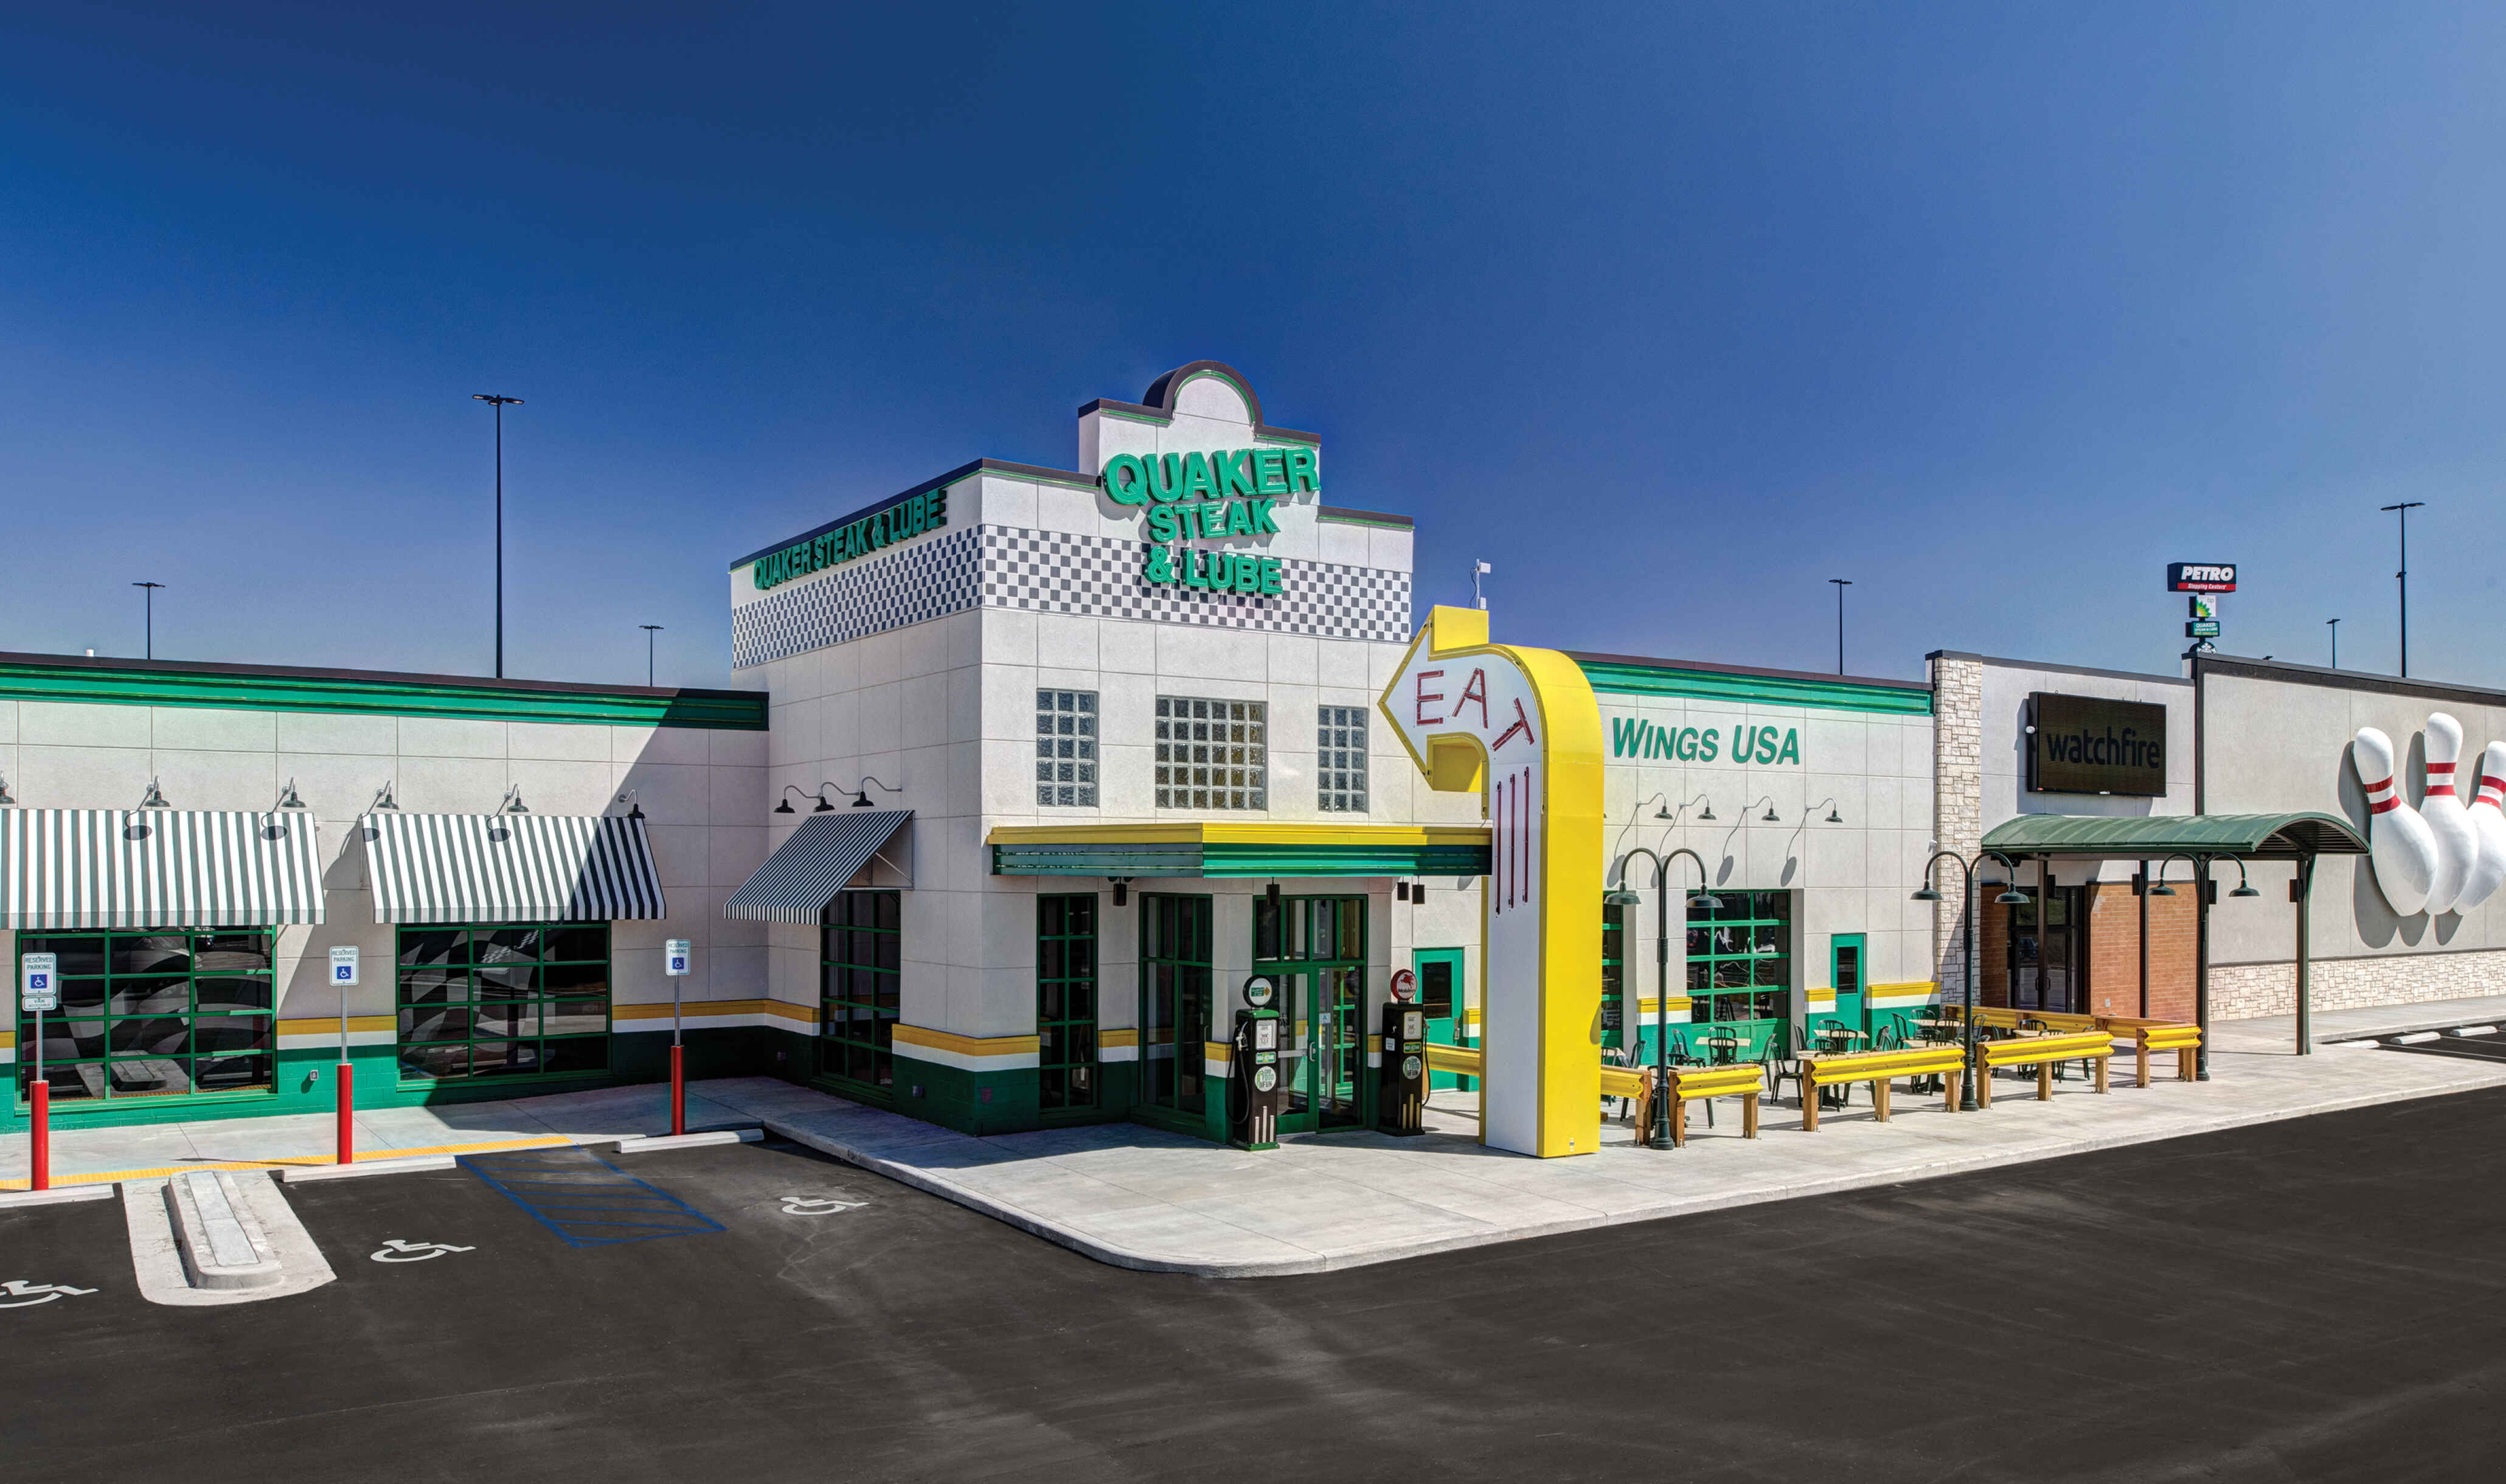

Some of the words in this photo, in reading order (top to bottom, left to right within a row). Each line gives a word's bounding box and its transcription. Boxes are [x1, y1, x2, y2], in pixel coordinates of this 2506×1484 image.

[1103, 446, 1321, 506] QUAKER
[754, 542, 812, 590] QUAKER
[814, 518, 870, 569] STEAK
[872, 513, 886, 548] &
[889, 489, 946, 542] LUBE
[1147, 498, 1280, 542] STEAK
[1144, 546, 1176, 583] &
[1183, 549, 1283, 594] LUBE
[2181, 566, 2234, 581] PETRO
[1417, 667, 1535, 752] EAT
[1612, 717, 1720, 762] WINGS
[1732, 725, 1799, 765] USA
[2047, 726, 2160, 769] watchfire
